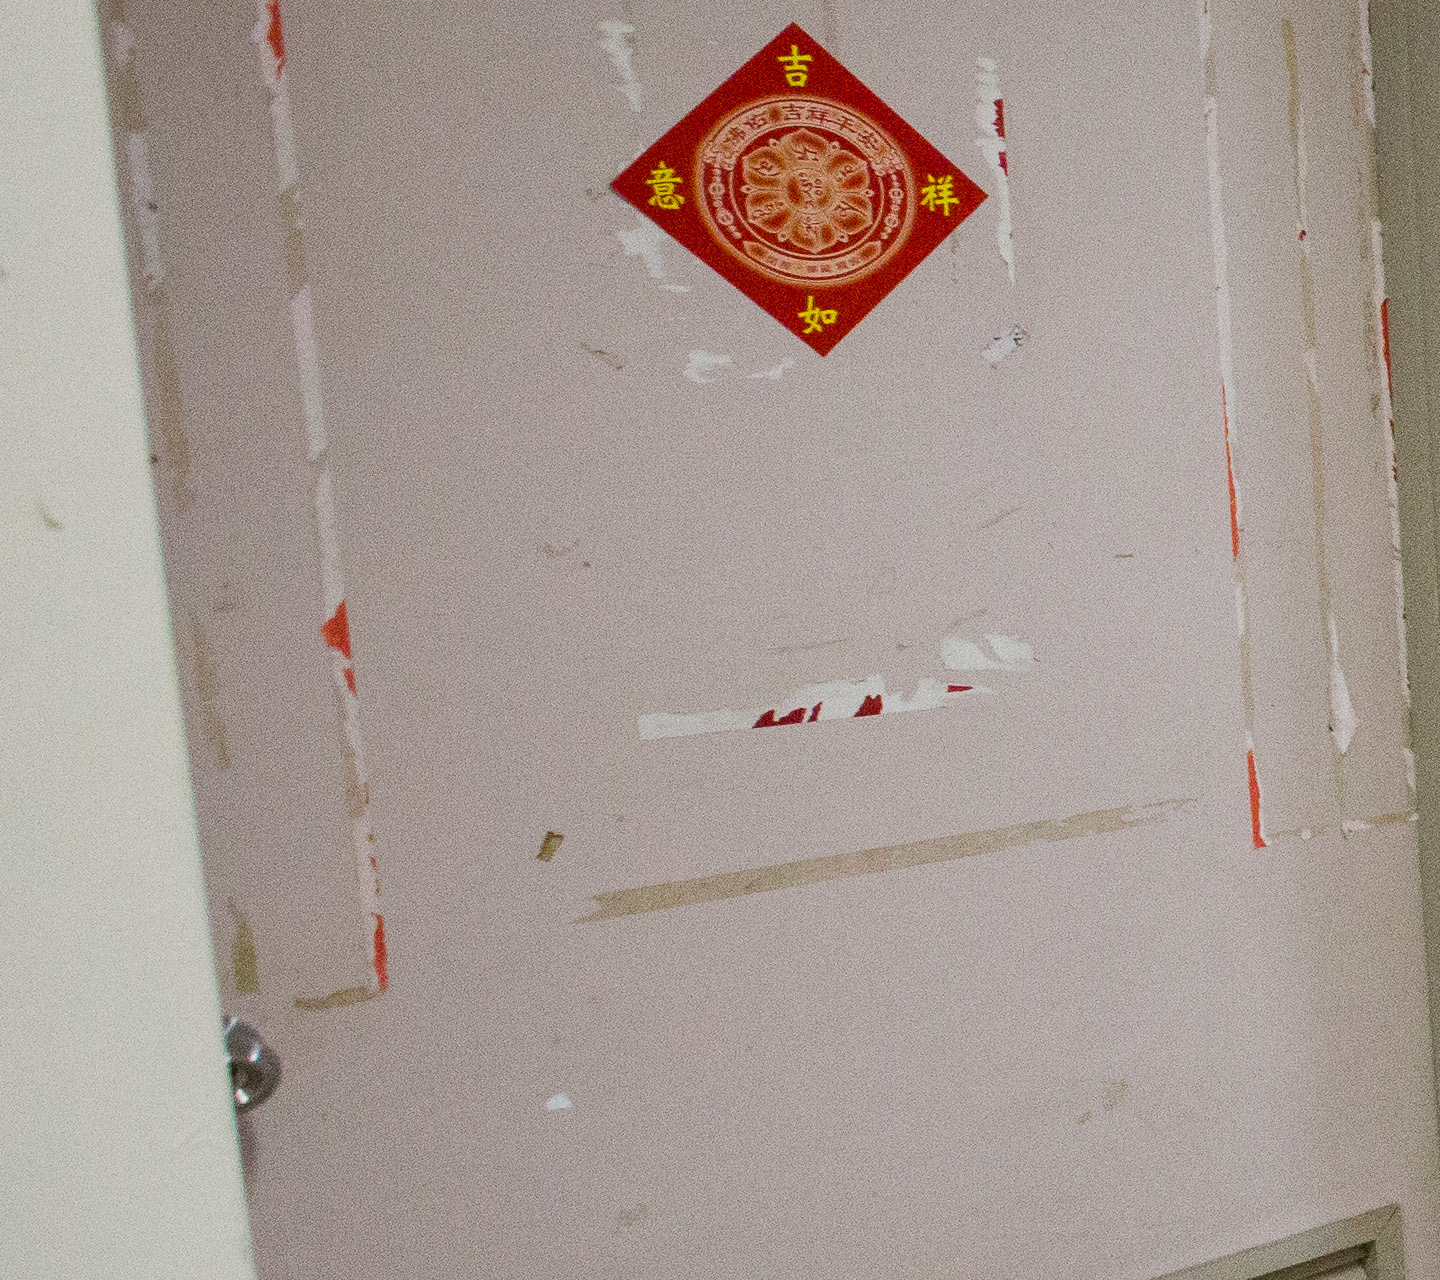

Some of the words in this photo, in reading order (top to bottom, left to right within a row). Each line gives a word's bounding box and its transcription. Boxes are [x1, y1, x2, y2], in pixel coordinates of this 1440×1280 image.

[776, 43, 813, 87] 吉
[645, 161, 686, 210] 意
[920, 173, 960, 217] 祥
[797, 295, 839, 334] 如
